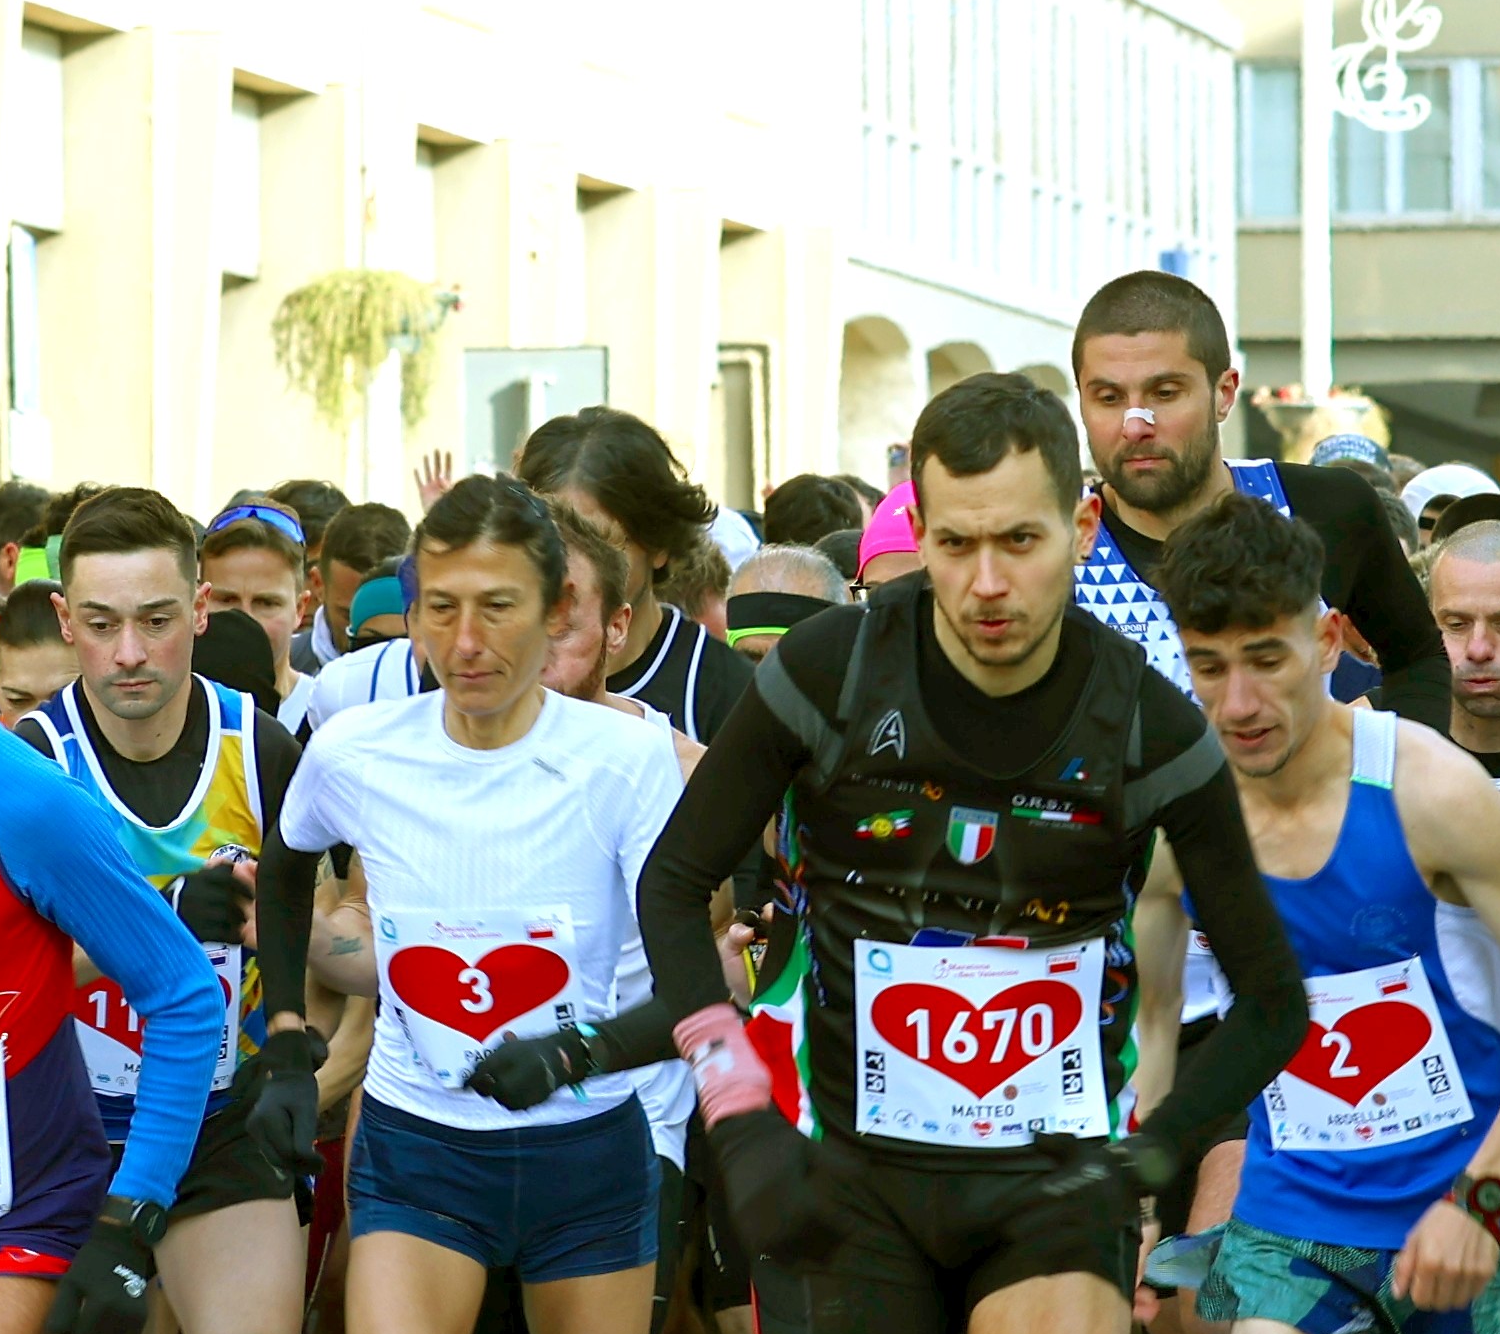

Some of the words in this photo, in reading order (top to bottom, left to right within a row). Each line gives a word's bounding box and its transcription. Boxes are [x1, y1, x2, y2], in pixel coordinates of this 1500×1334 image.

[457, 967, 494, 1014] 3
[905, 1002, 1054, 1065] 1670
[1320, 1030, 1361, 1079] 2
[952, 1104, 1015, 1118] MATTEO
